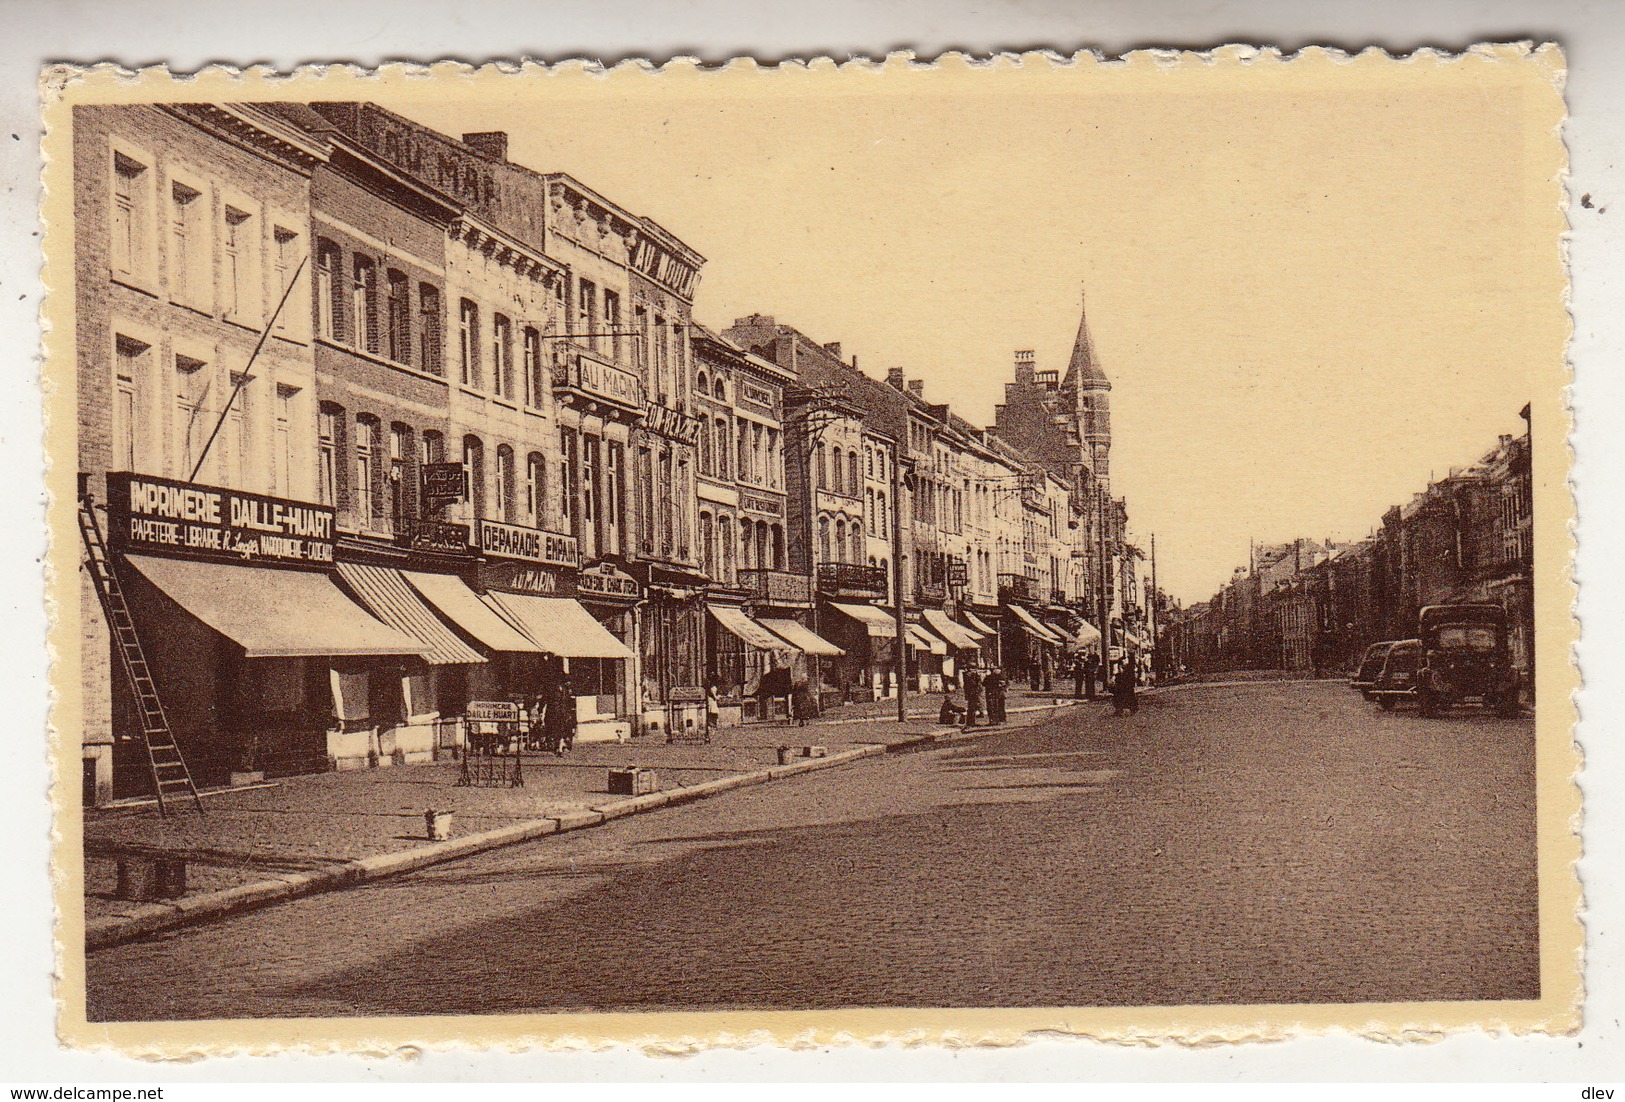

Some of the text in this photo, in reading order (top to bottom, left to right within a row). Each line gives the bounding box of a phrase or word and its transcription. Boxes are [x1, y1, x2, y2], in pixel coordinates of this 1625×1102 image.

[635, 238, 656, 275] AU
[582, 362, 599, 391] AU
[130, 480, 334, 540] IMPRIMERIE DAILLE-HUART
[483, 524, 540, 559] DEPARADIS
[545, 535, 578, 564] EMPAIN
[511, 574, 526, 590] AU
[524, 569, 558, 593] MARIN
